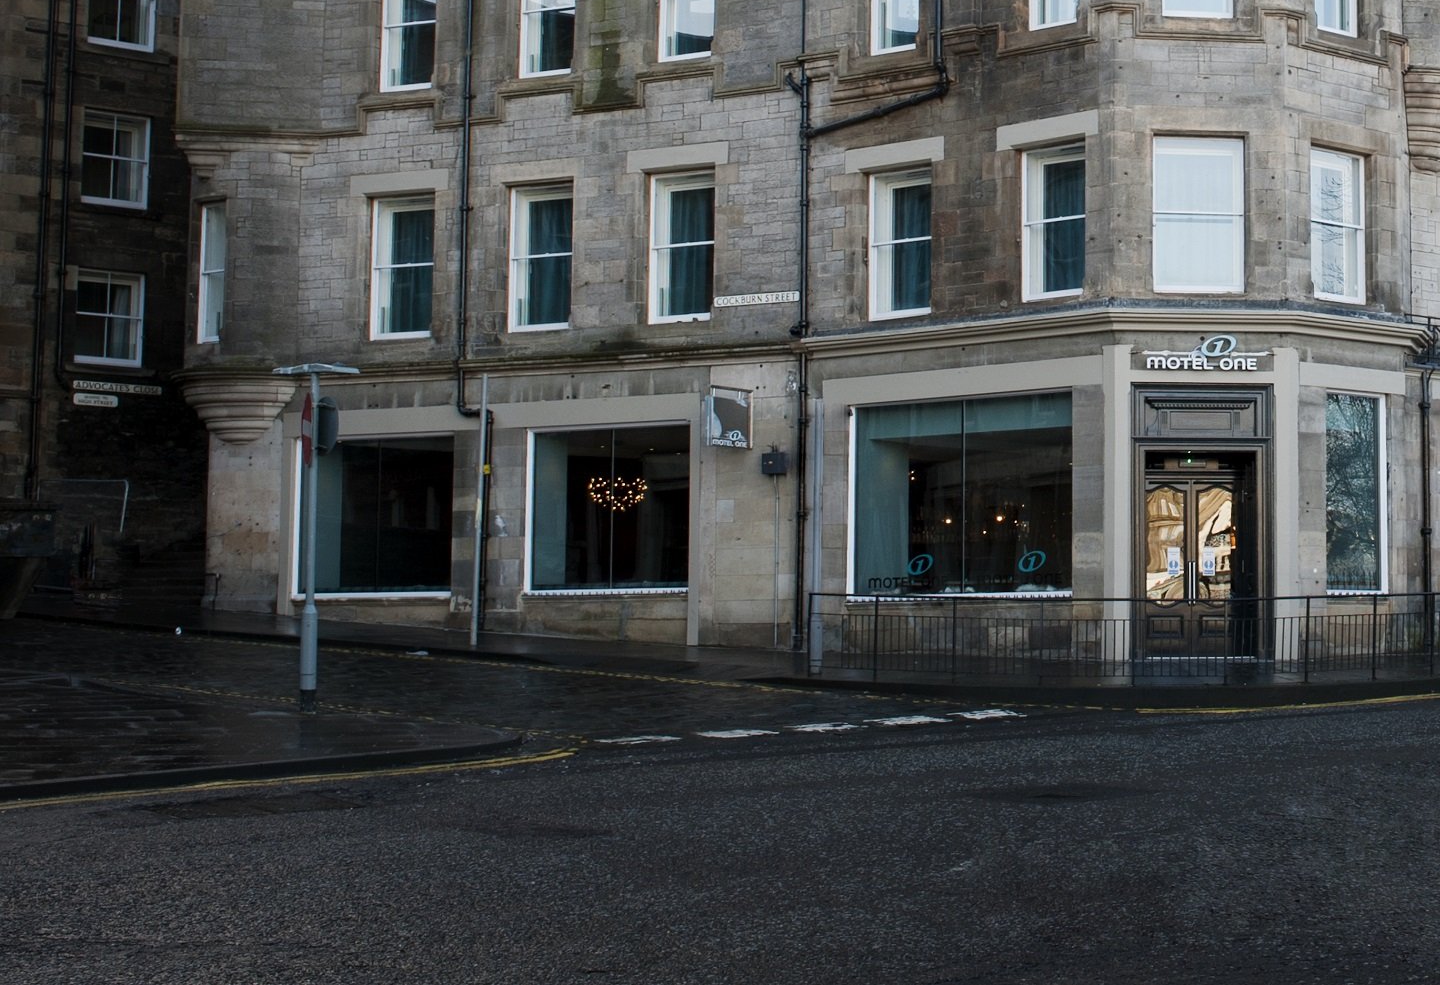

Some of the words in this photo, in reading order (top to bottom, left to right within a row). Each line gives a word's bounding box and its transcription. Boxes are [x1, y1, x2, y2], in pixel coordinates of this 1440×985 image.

[716, 294, 762, 306] COCKBURN
[765, 292, 796, 303] STREET
[1146, 356, 1213, 370] MOTEL
[1219, 357, 1257, 370] ONE
[75, 381, 130, 392] ADVOCATES
[133, 386, 159, 395] CLOSE
[712, 438, 734, 448] MOTEL
[734, 440, 748, 449] ONE
